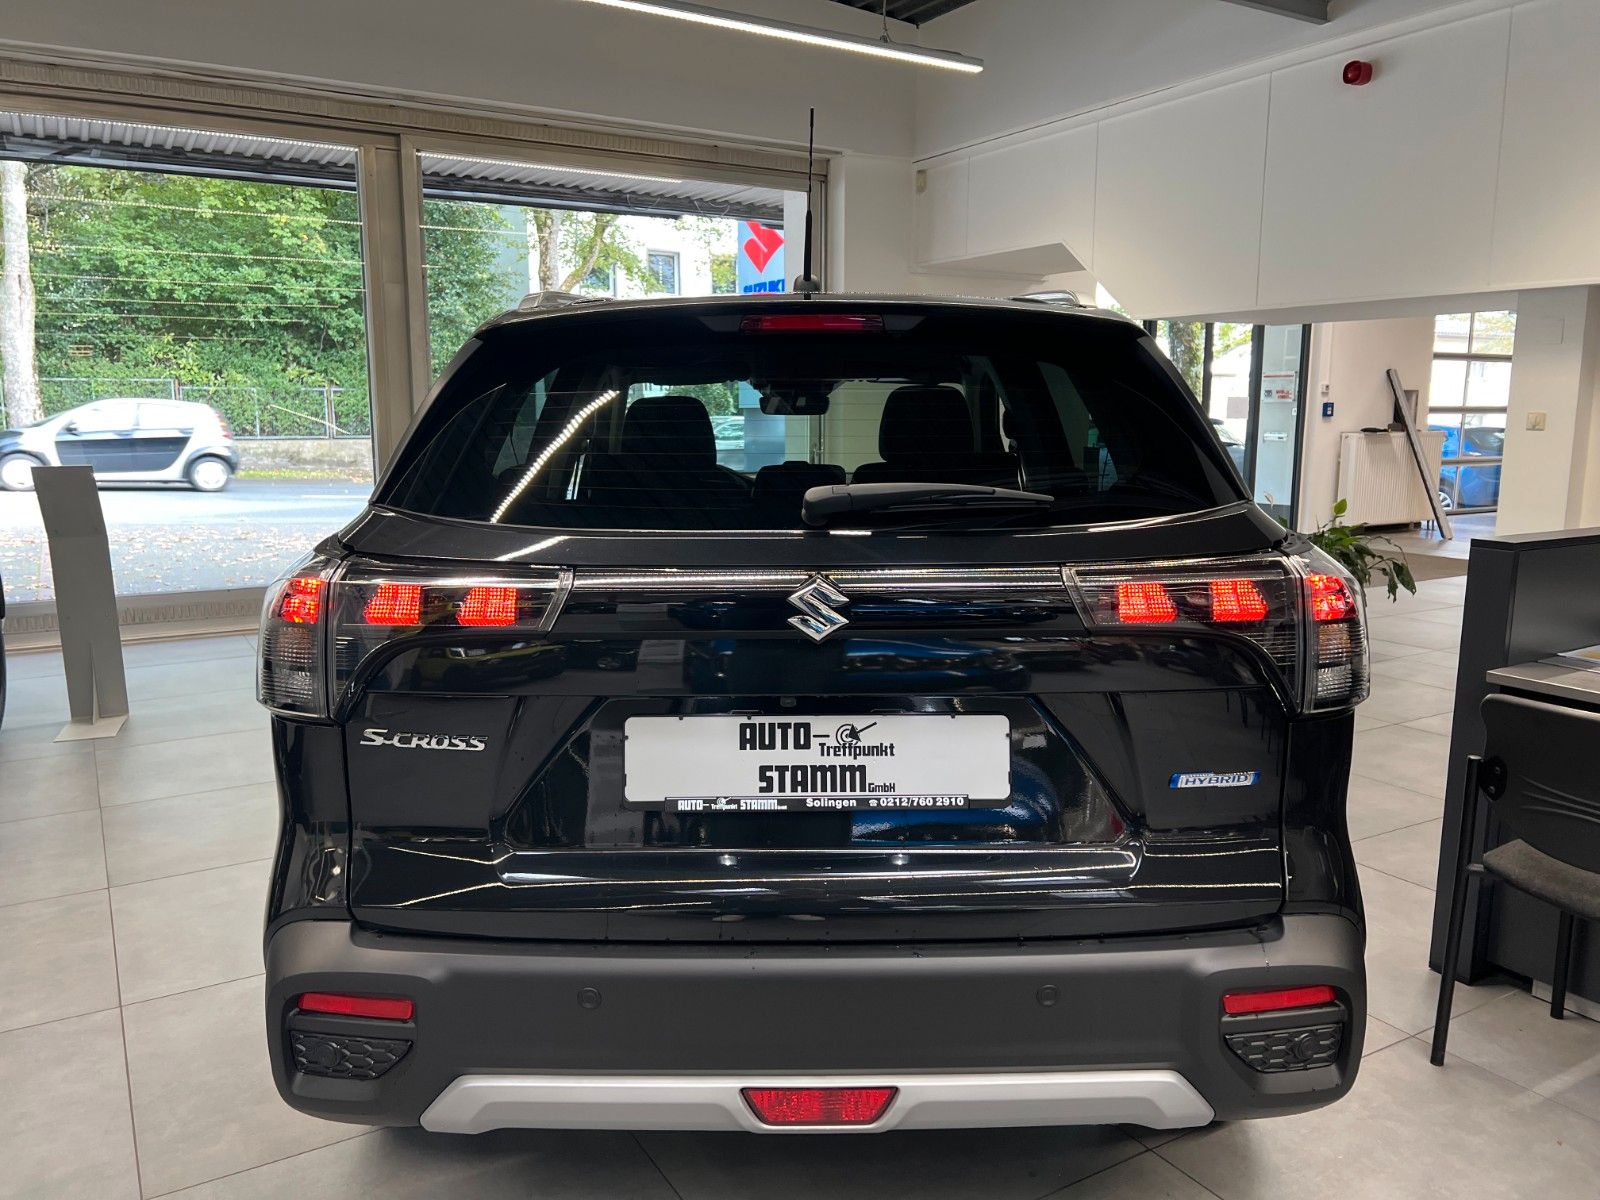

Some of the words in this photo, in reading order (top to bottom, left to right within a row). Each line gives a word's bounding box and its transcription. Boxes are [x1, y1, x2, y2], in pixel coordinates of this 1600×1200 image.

[360, 728, 488, 751] S-CROSS
[818, 742, 895, 760] Treffpunkt
[759, 764, 867, 793] STAMM
[868, 782, 896, 793] GmbH
[1184, 773, 1249, 786] HYBRID
[740, 799, 778, 811] STAMM
[806, 797, 857, 810] Solingen
[879, 796, 934, 808] 0212/760
[935, 796, 965, 807] 2910
